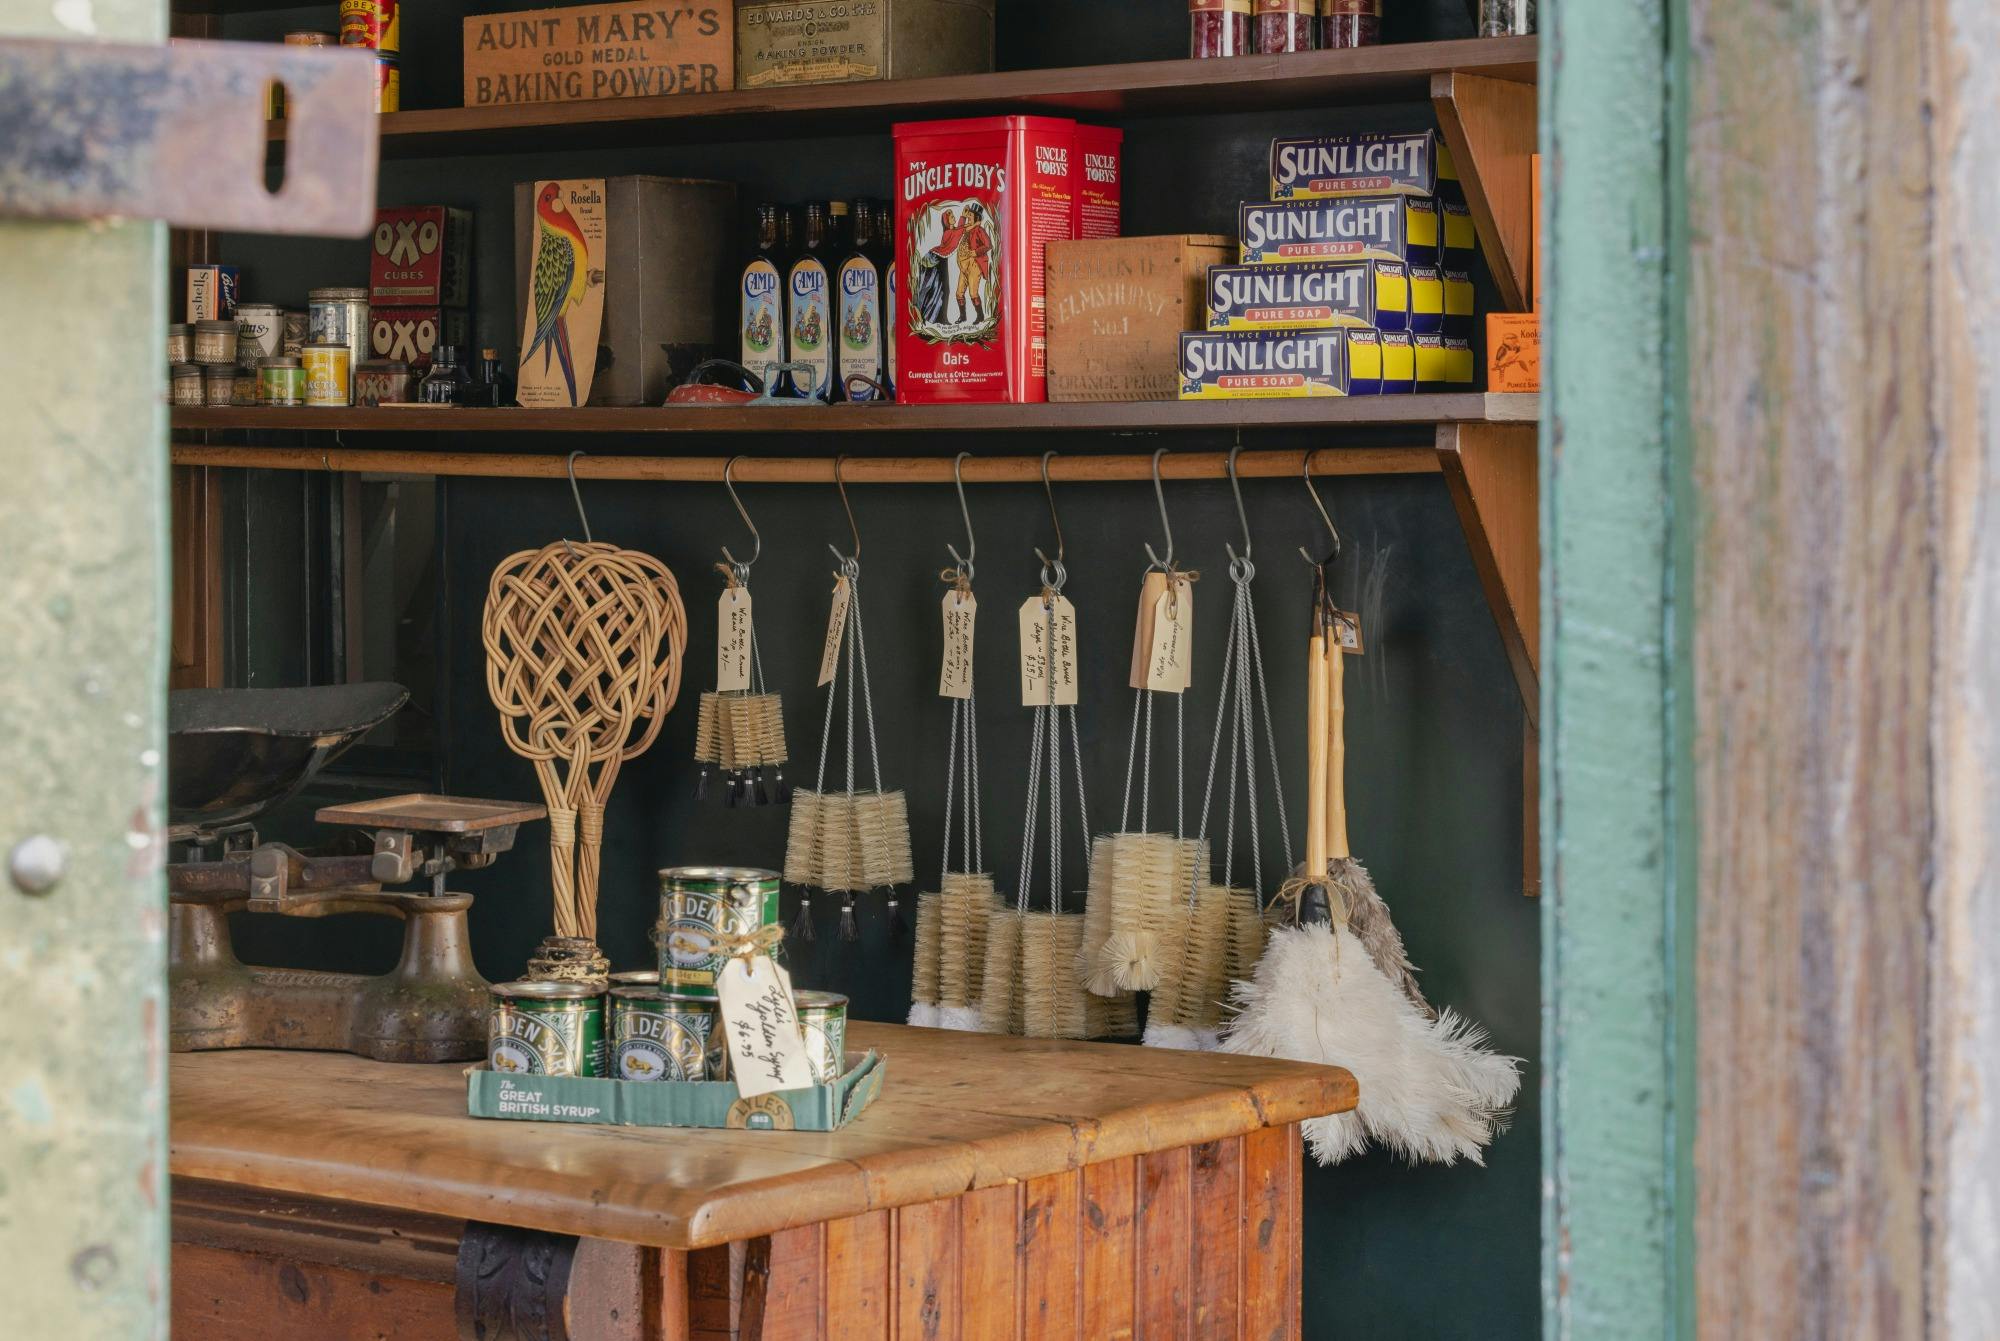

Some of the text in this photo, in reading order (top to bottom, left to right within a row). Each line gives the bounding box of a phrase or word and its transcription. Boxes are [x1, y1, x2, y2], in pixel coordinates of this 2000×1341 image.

[747, 7, 814, 26] EDWARDS
[476, 8, 721, 51] AUNT MARY'S
[543, 46, 649, 67] GOLD MEDAL
[755, 43, 866, 61] BAKING POWDER
[476, 71, 583, 104] BAKING
[591, 63, 720, 98] POWDER
[1318, 136, 1351, 144] SINCE
[1035, 145, 1067, 162] UNCLE
[1085, 153, 1116, 169] UNCLE
[1279, 139, 1425, 184] SUNLIGHT
[910, 161, 927, 171] MY
[904, 163, 1006, 201] UNCLE TOBY'S
[1318, 179, 1383, 190] PURE SOAP
[571, 190, 602, 205] Rosella
[1286, 200, 1320, 208] SINCE
[1247, 204, 1396, 249] SUNLIGHT
[374, 219, 439, 266] OXO
[1288, 244, 1354, 255] PURE SOAP
[384, 271, 424, 280] CUBES
[1378, 264, 1402, 275] SUNLIGHT
[745, 272, 776, 298] CAMP
[793, 270, 824, 296] CAMP
[842, 268, 876, 295] CAMP
[192, 271, 209, 320] ushells
[1214, 269, 1365, 313] SUNLIGHT
[1254, 309, 1322, 320] PURE SOAP
[372, 319, 436, 364] OXO
[1351, 332, 1376, 342] SUNLIGHT
[1383, 334, 1408, 343] SUNLIGHT
[1416, 335, 1441, 345] SUNLIGHT
[239, 348, 262, 358] KING
[943, 351, 970, 365] Oats
[1186, 336, 1337, 380] SUNLIGHT
[933, 371, 948, 379] LOVE
[1227, 376, 1294, 387] PURE SOAP
[359, 378, 393, 400] OXO
[1156, 656, 1165, 679] Made
[662, 897, 724, 924] GOLDEN
[500, 1080, 516, 1090] The
[499, 1090, 543, 1103] GREAT
[499, 1101, 549, 1115] BRITISH
[736, 1098, 784, 1117] LYLE'S
